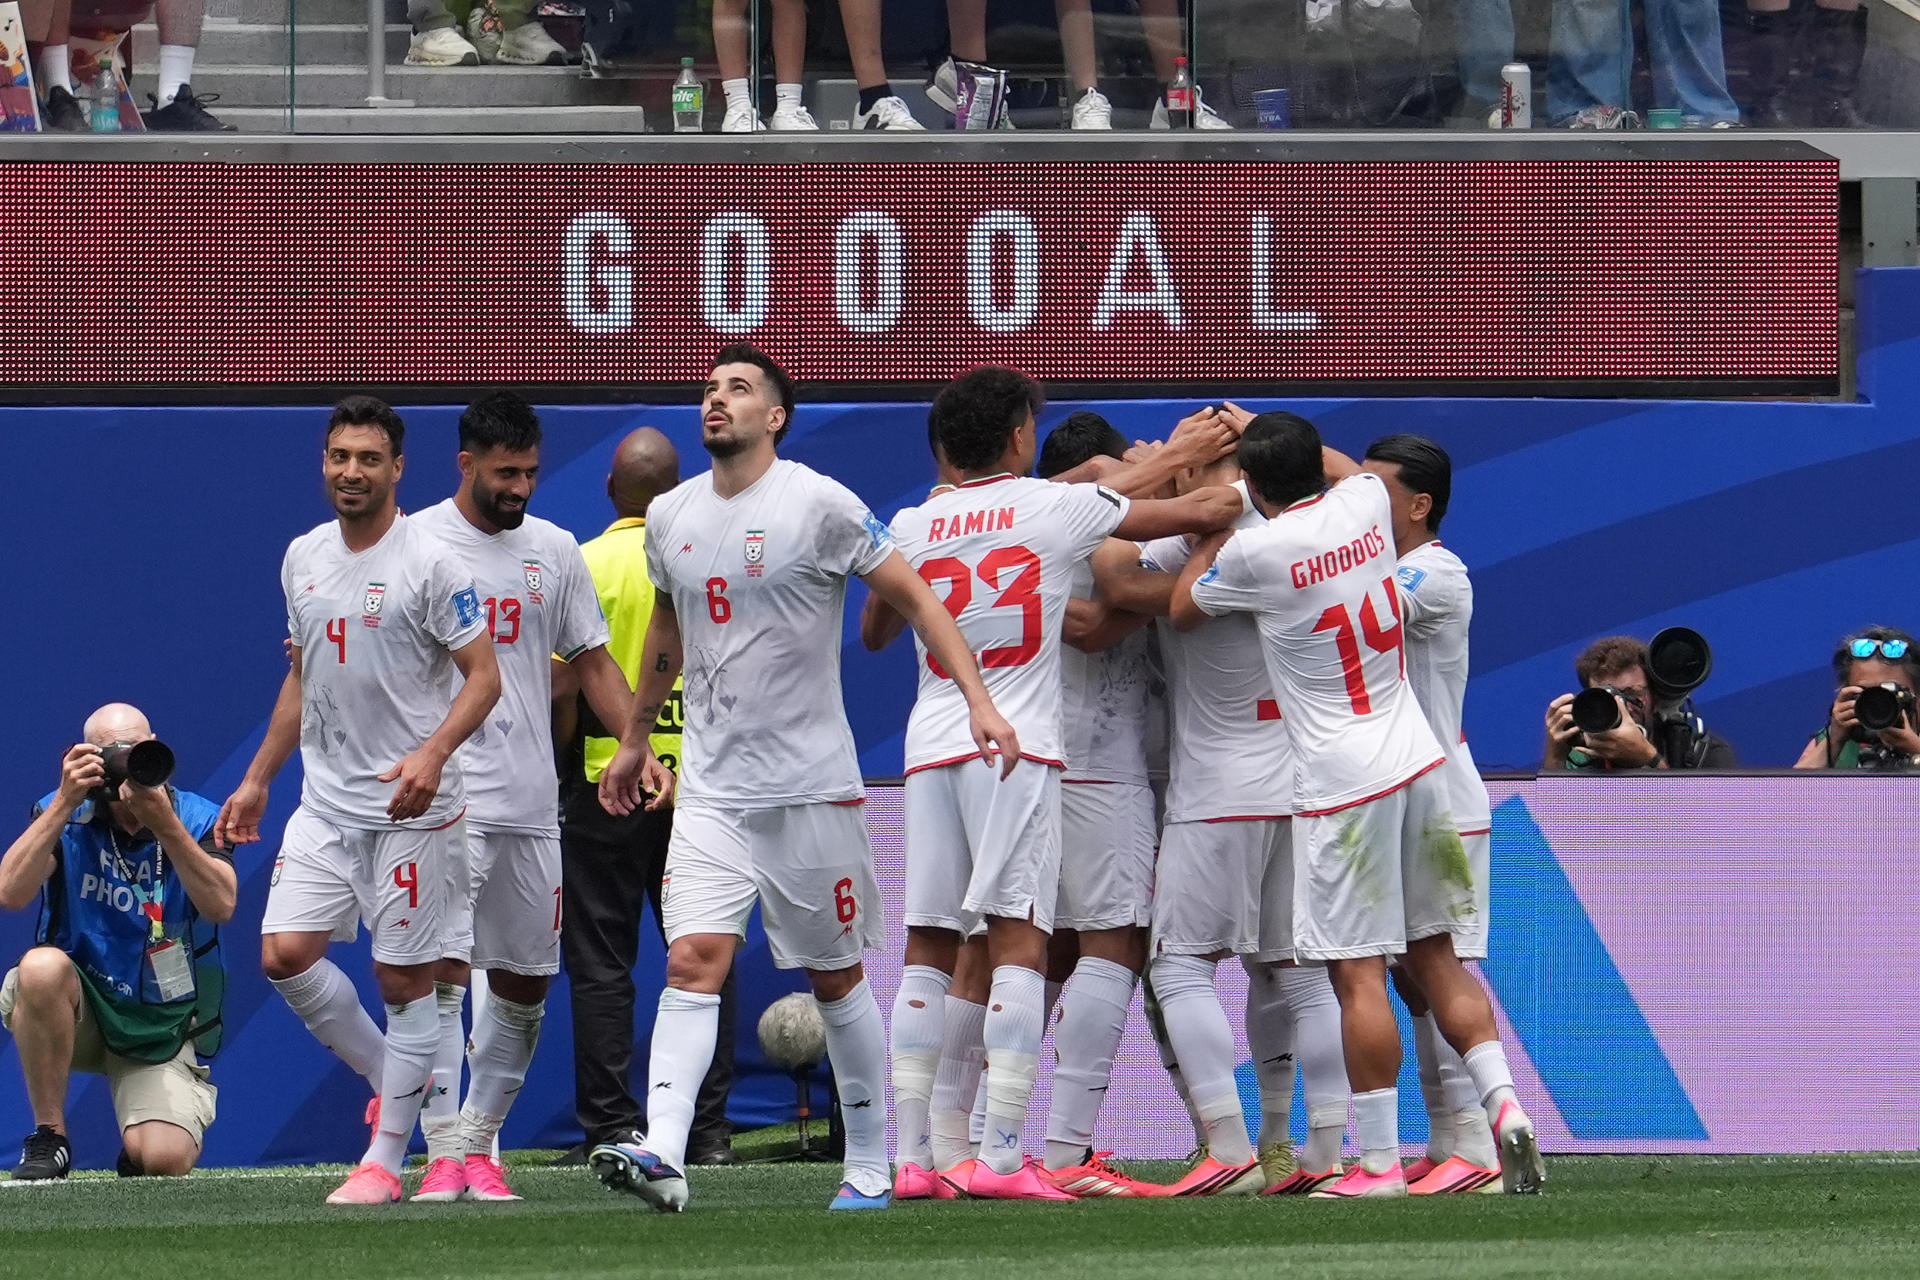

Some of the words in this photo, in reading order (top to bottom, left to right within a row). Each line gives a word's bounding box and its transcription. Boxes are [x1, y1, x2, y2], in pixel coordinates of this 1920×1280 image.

[563, 210, 1320, 334] GOOOAL
[928, 507, 1015, 542] RAMIN
[1291, 524, 1386, 589] GHODDOS
[482, 597, 522, 643] 13
[706, 577, 732, 624] 6
[326, 618, 346, 664] 4
[1308, 576, 1406, 716] 14
[100, 848, 152, 885] FIFA
[394, 862, 418, 908] 4
[834, 877, 857, 923] 6
